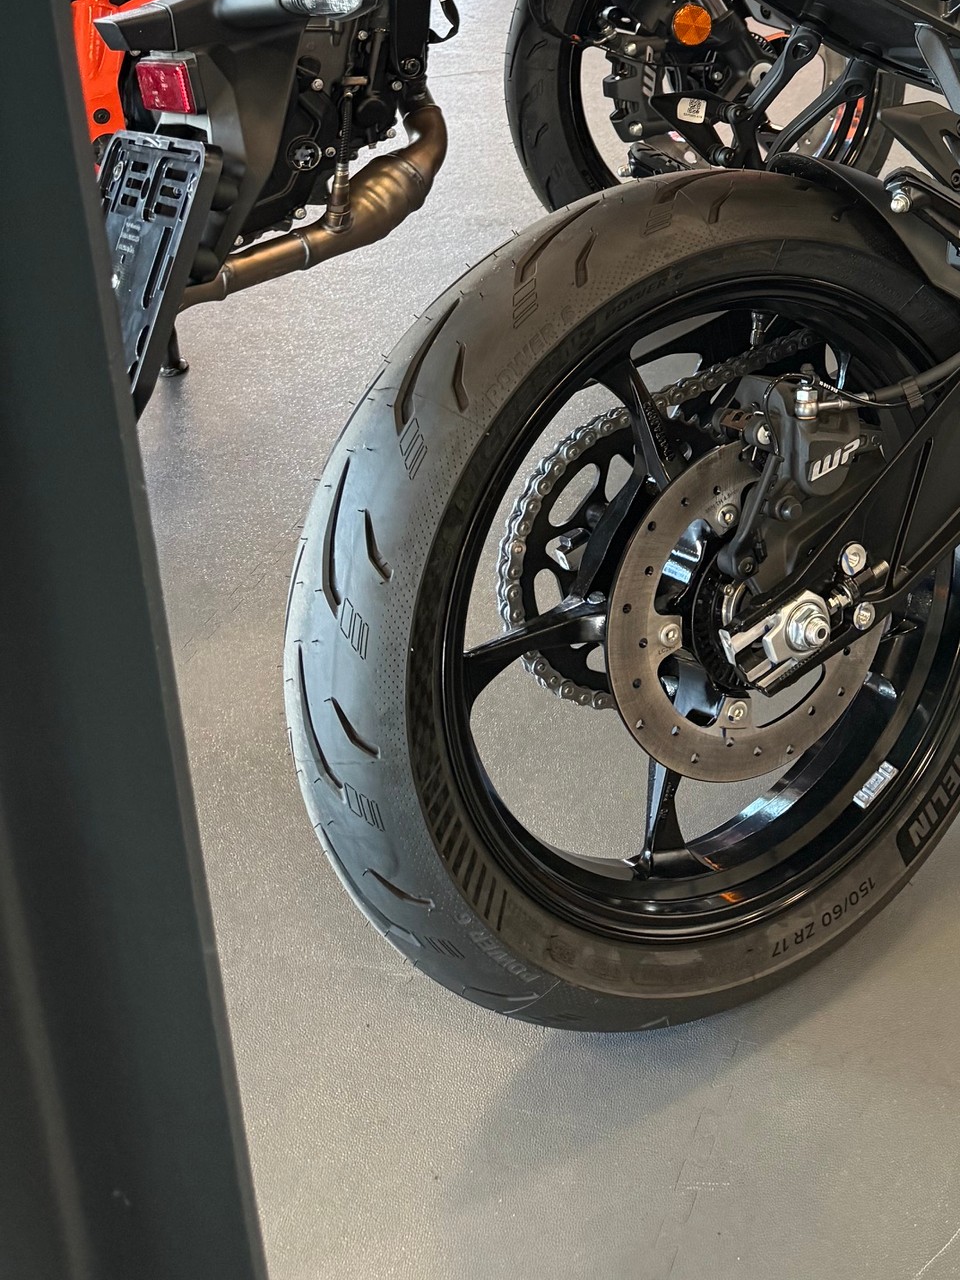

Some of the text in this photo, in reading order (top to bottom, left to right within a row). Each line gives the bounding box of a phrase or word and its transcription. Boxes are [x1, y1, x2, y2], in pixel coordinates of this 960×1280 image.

[604, 279, 671, 321] POWER
[484, 323, 557, 408] POWER
[810, 438, 861, 482] WP
[771, 876, 877, 958] 150/60 ZR 17
[468, 930, 541, 983] POWER
